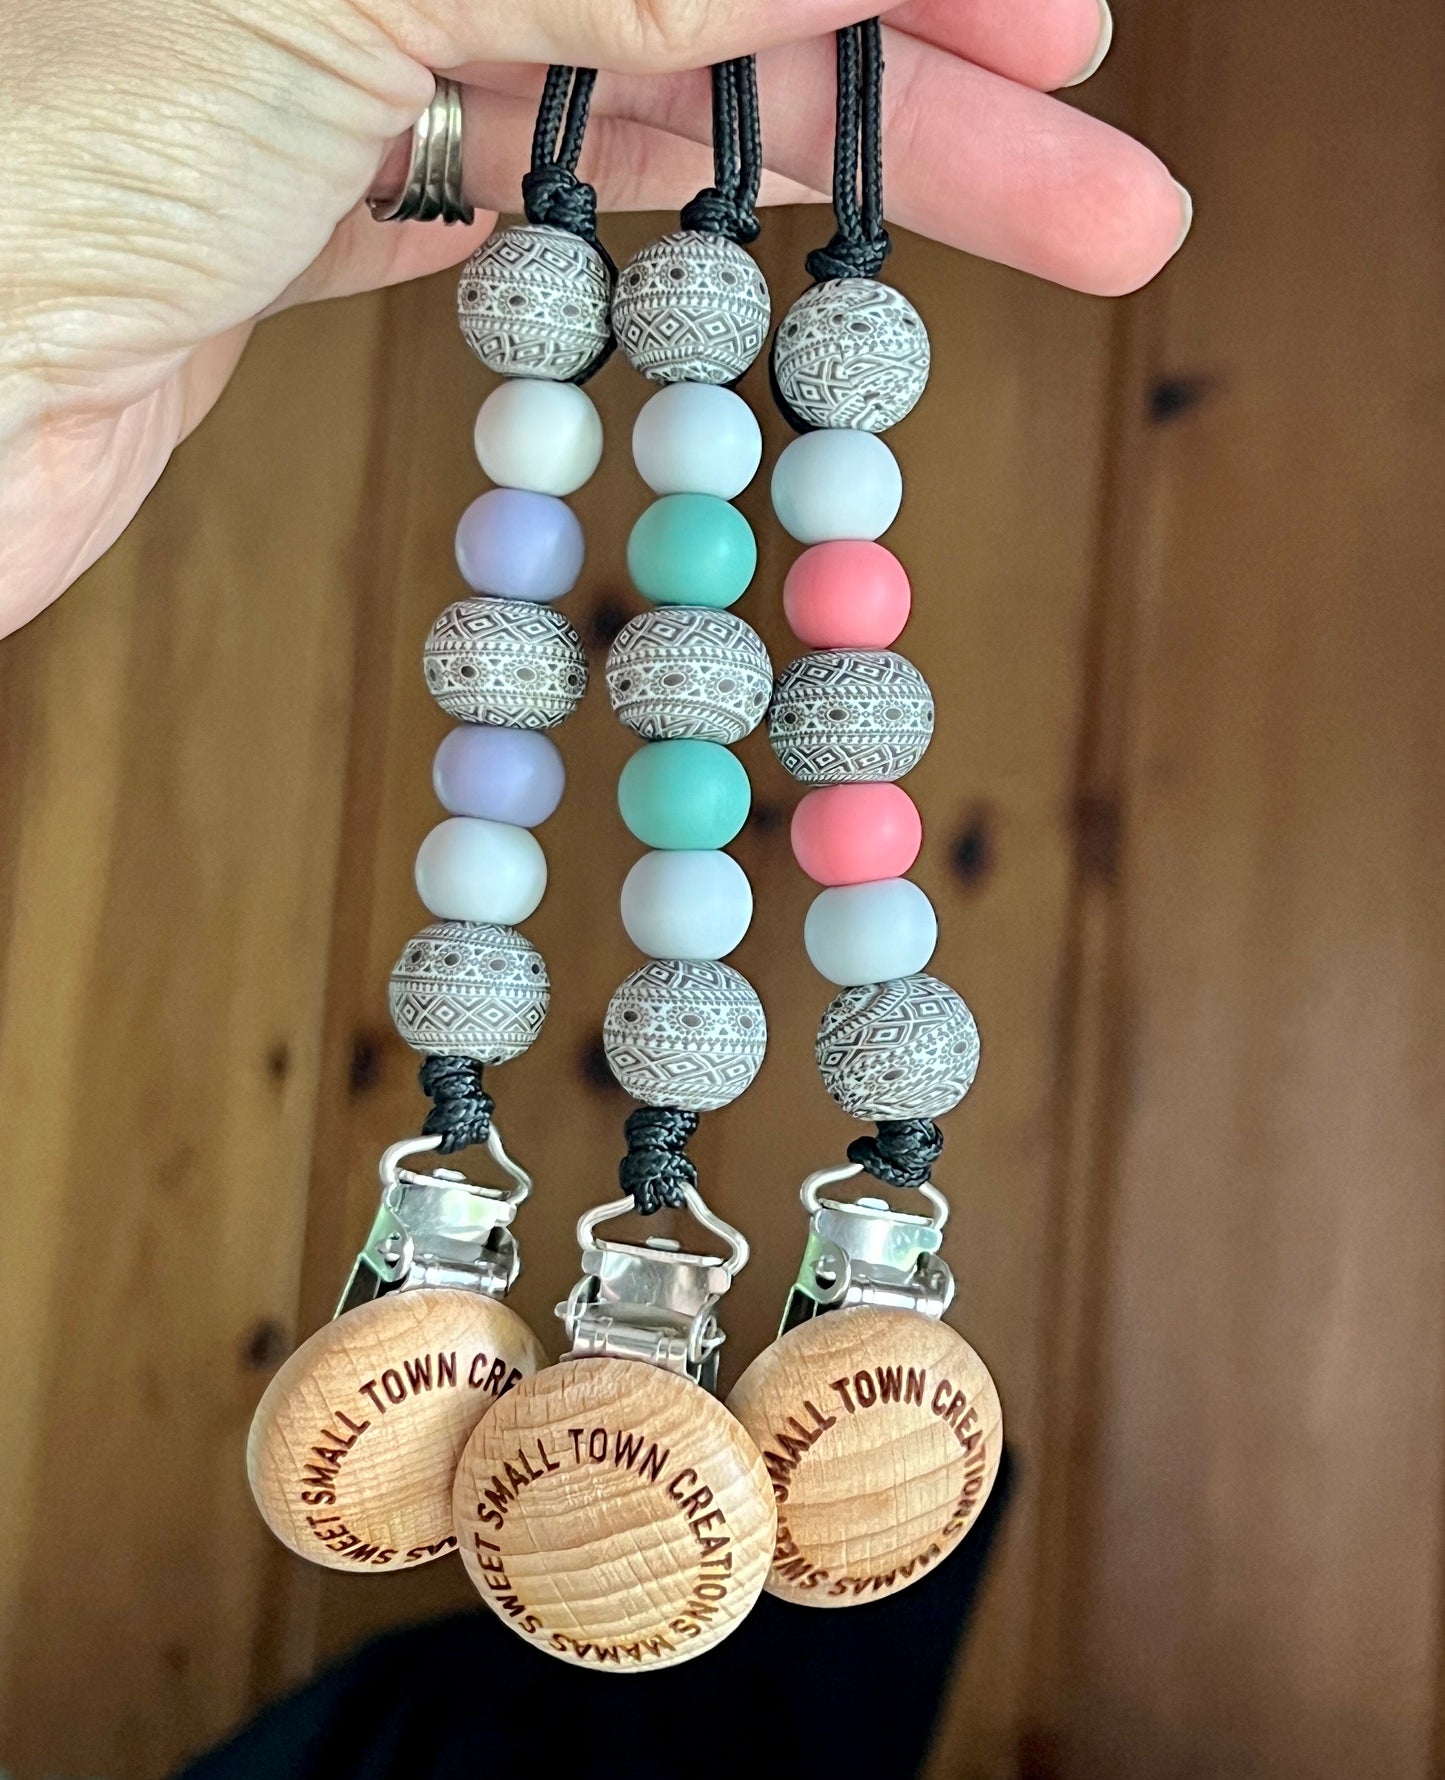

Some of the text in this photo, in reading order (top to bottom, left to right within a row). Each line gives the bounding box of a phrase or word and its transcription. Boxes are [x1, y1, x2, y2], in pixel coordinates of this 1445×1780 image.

[302, 1352, 523, 1564] SWEET SMALL TOWN CRE
[475, 1428, 732, 1663] MAMAS SWEET SMALL TOWN CREATIONS
[829, 1365, 926, 1414] TOWN
[931, 1379, 986, 1538] CREATIONS
